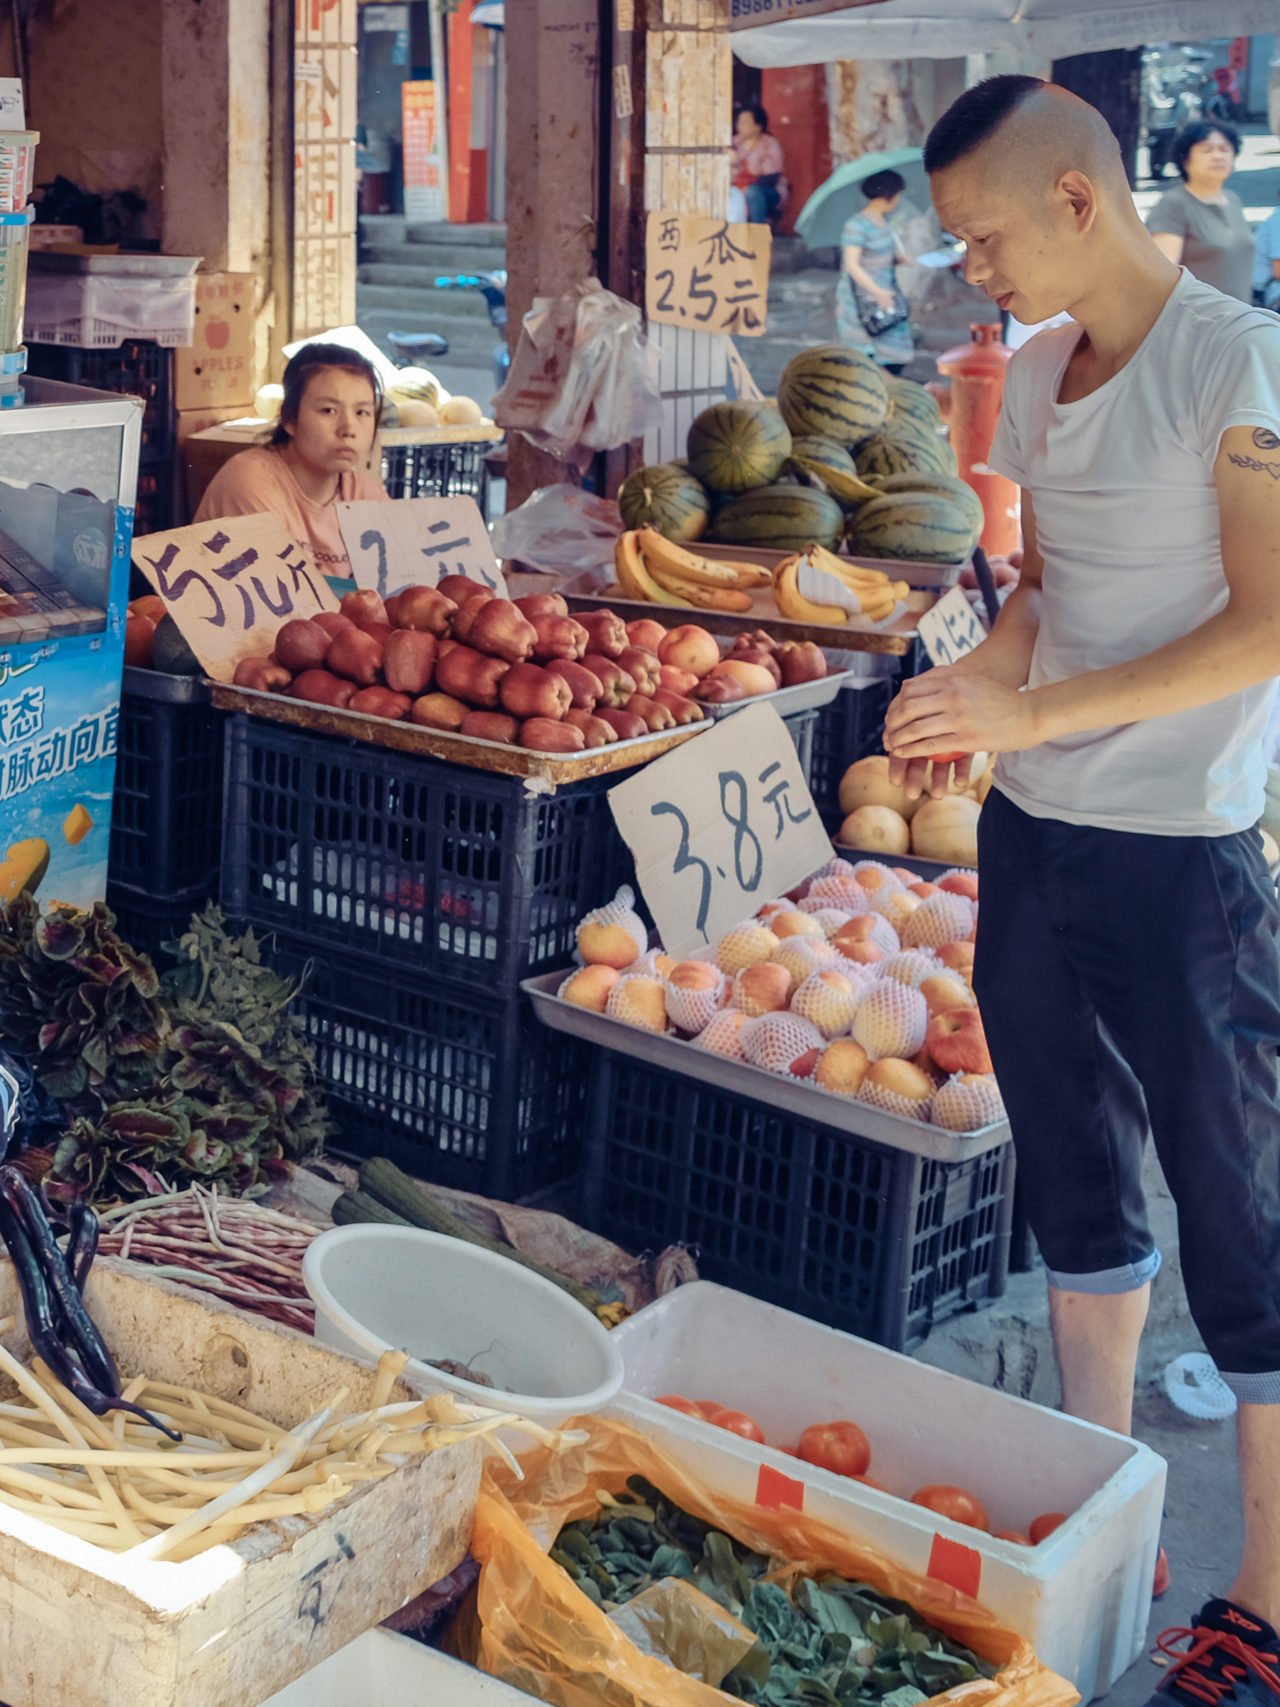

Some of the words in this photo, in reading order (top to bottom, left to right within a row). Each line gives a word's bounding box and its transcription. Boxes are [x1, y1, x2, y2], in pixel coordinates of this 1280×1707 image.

[657, 218, 756, 266] 西瓜
[655, 266, 763, 331] 2.5元
[650, 762, 812, 945] 3.8元
